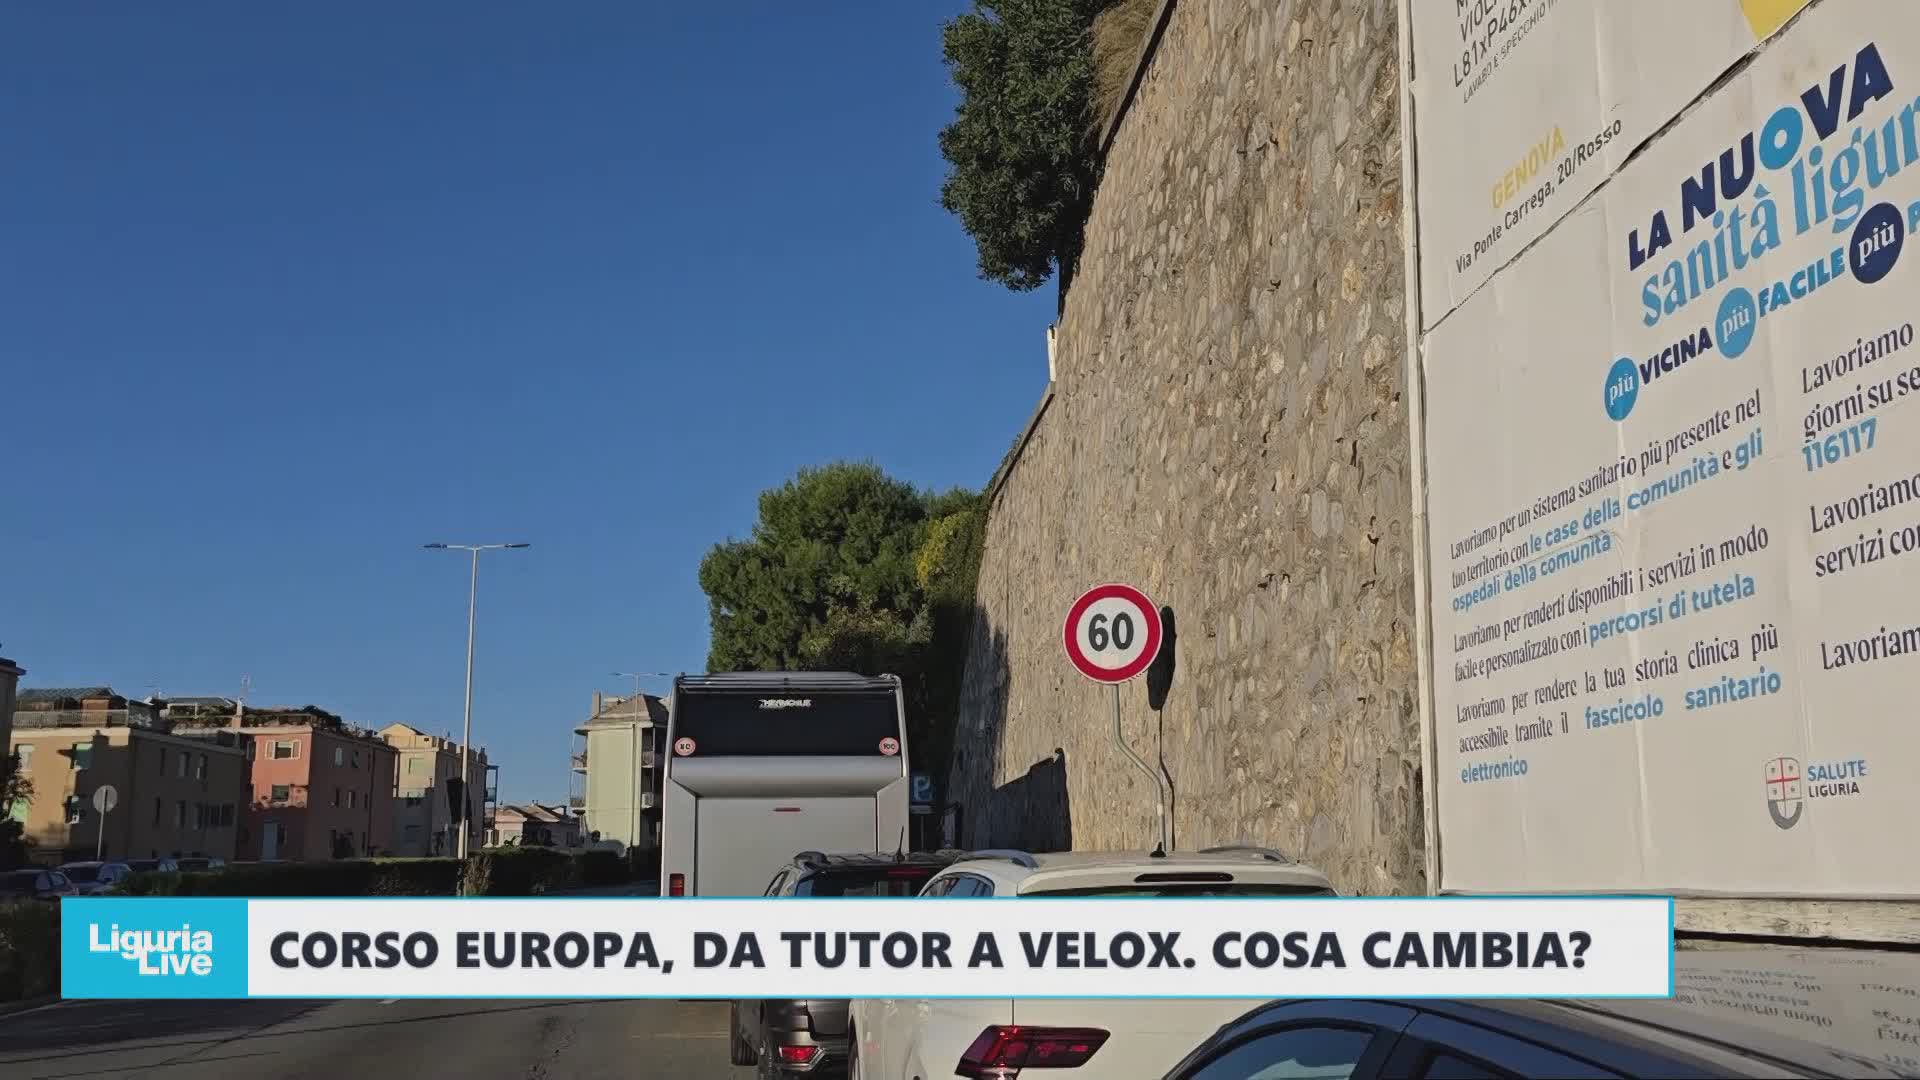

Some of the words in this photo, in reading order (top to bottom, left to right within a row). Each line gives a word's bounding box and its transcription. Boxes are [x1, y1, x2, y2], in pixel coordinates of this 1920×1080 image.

[1454, 0, 1531, 87] L81xP46x
[1461, 0, 1497, 42] VIOL
[1464, 65, 1492, 104] LAVABO
[1501, 2, 1546, 60] SPECCHIO
[1456, 253, 1472, 273] Via
[1474, 225, 1502, 260] Ponte
[1505, 181, 1555, 229] Carrega,
[1557, 119, 1621, 185] 20/Rosso
[1492, 126, 1566, 209] GENOVA
[1628, 209, 1673, 271] LA
[1681, 42, 1894, 233] NUOVA
[1641, 184, 1781, 327] sanità
[1609, 374, 1635, 407] più
[1639, 327, 1713, 386] VICINA
[1721, 304, 1751, 343] più
[1757, 246, 1846, 318] FACILE
[1857, 221, 1896, 267] più
[1802, 323, 1914, 394] Lavoriamo
[1802, 417, 1877, 472] 116117
[1804, 384, 1864, 443] giorni
[1867, 379, 1893, 409] su
[1450, 525, 1497, 560] Lavoriamo
[1499, 514, 1516, 542] per
[1518, 508, 1531, 528] un
[1533, 485, 1576, 519] sistema
[1578, 455, 1637, 498] sanitario
[1640, 440, 1662, 476] più
[1665, 409, 1730, 465] presente
[1735, 388, 1761, 424] nel
[1452, 570, 1465, 589] tuo
[1467, 548, 1509, 582] territorio
[1510, 542, 1529, 563] con
[1530, 534, 1542, 553] le
[1546, 519, 1579, 546] case
[1583, 498, 1621, 530] della
[1627, 452, 1719, 510] comunità
[1722, 450, 1732, 470] e
[1735, 427, 1763, 471] gli
[1810, 473, 1920, 533] Lavoriamo
[1453, 575, 1500, 612] ospedali
[1504, 563, 1536, 592] della
[1540, 529, 1611, 576] comunità
[1454, 623, 1500, 653] Lavoriamo
[1503, 615, 1521, 641] per
[1523, 594, 1565, 630] renderti
[1568, 569, 1633, 613] disponibili
[1639, 567, 1644, 592] i
[1648, 547, 1696, 588] servizi
[1700, 543, 1716, 570] in
[1720, 524, 1769, 562] modo
[1815, 528, 1885, 577] servizi
[1088, 611, 1134, 652] 60
[1454, 658, 1477, 682] facile
[1479, 659, 1485, 674] e
[1486, 635, 1559, 680] personalizzato
[1560, 628, 1582, 650] con
[1583, 621, 1588, 645] i
[1589, 598, 1663, 649] percorsi
[1669, 590, 1686, 620] di
[1692, 573, 1755, 612] tutela
[1457, 697, 1505, 724] Lavoriamo
[1511, 691, 1528, 716] per
[1534, 678, 1577, 705] rendere
[1584, 671, 1597, 694] la
[1604, 667, 1626, 690] tua
[1635, 650, 1678, 682] storia
[1688, 636, 1740, 670] clinica
[1751, 623, 1779, 662] più
[1459, 725, 1509, 753] accessibile
[1515, 715, 1553, 743] tramite
[1561, 711, 1569, 734] il
[1584, 693, 1664, 730] fascicolo
[1685, 665, 1781, 710] sanitario
[1461, 754, 1528, 784] elettronico
[1807, 759, 1868, 782] SALUTE
[1809, 781, 1860, 798] LIGURIA
